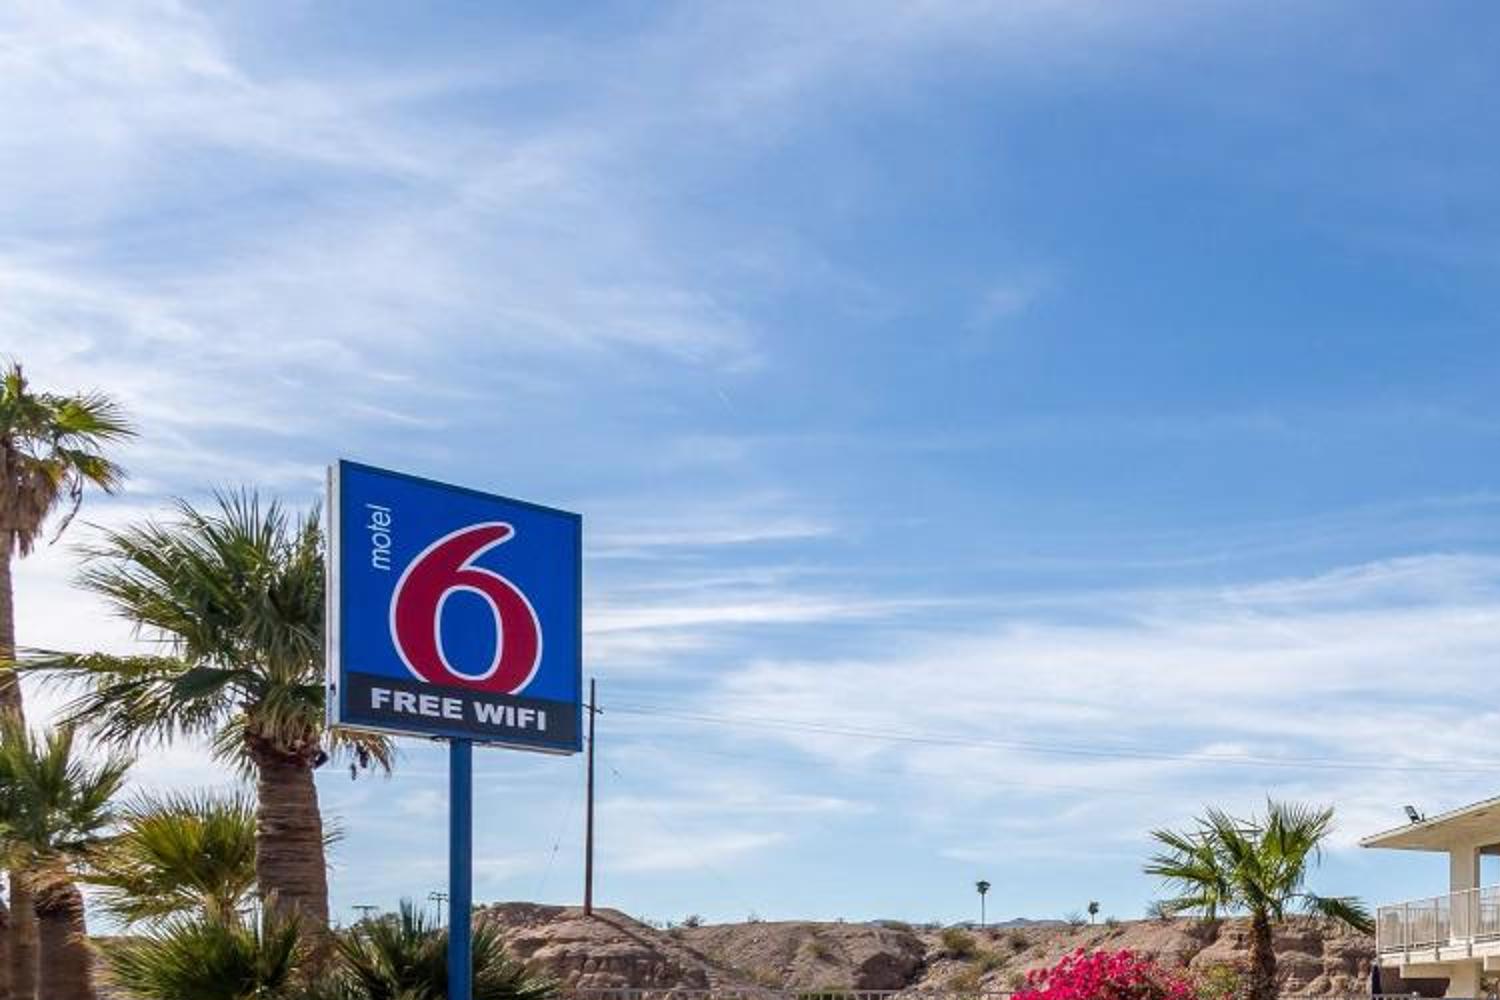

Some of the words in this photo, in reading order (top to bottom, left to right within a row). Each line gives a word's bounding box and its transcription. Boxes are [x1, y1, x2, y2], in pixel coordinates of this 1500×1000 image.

[365, 503, 391, 571] motel
[389, 521, 543, 696] 6
[371, 687, 463, 719] FREE
[474, 701, 547, 731] WIFI
